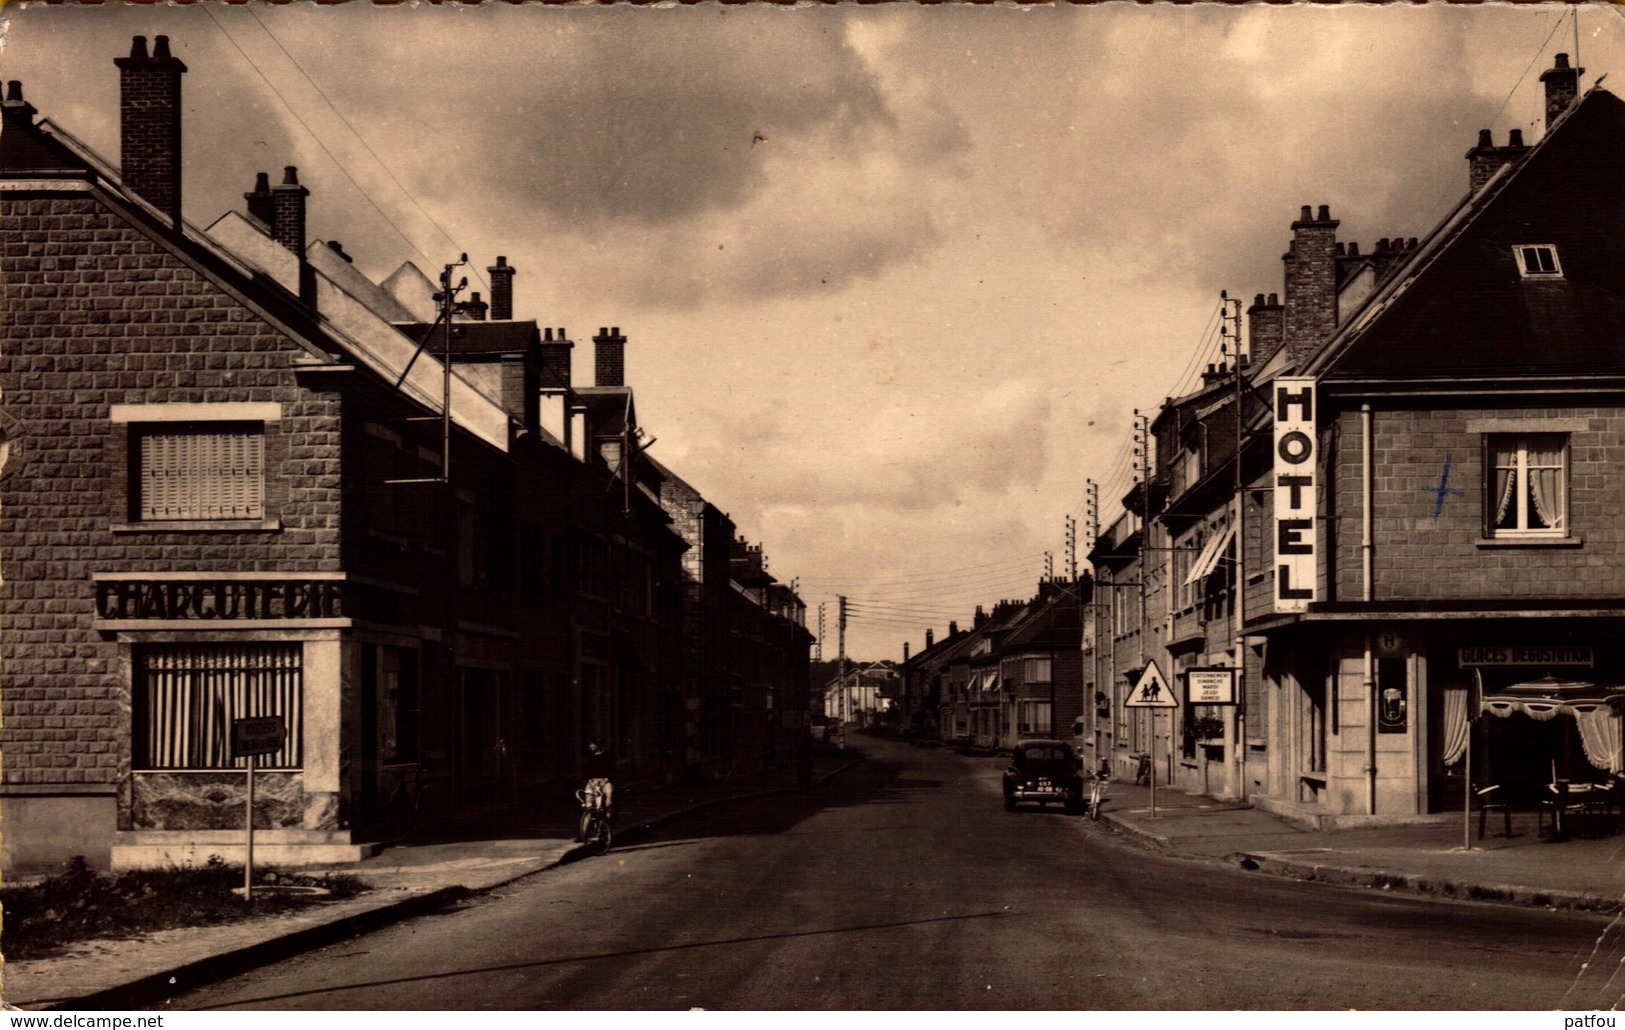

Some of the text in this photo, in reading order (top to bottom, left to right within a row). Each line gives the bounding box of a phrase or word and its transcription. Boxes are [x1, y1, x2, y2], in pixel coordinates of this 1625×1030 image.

[1278, 387, 1313, 599] HOTEL
[96, 581, 343, 620] CHARCUTERIE
[1461, 647, 1591, 663] GLACES DEGUSTATION
